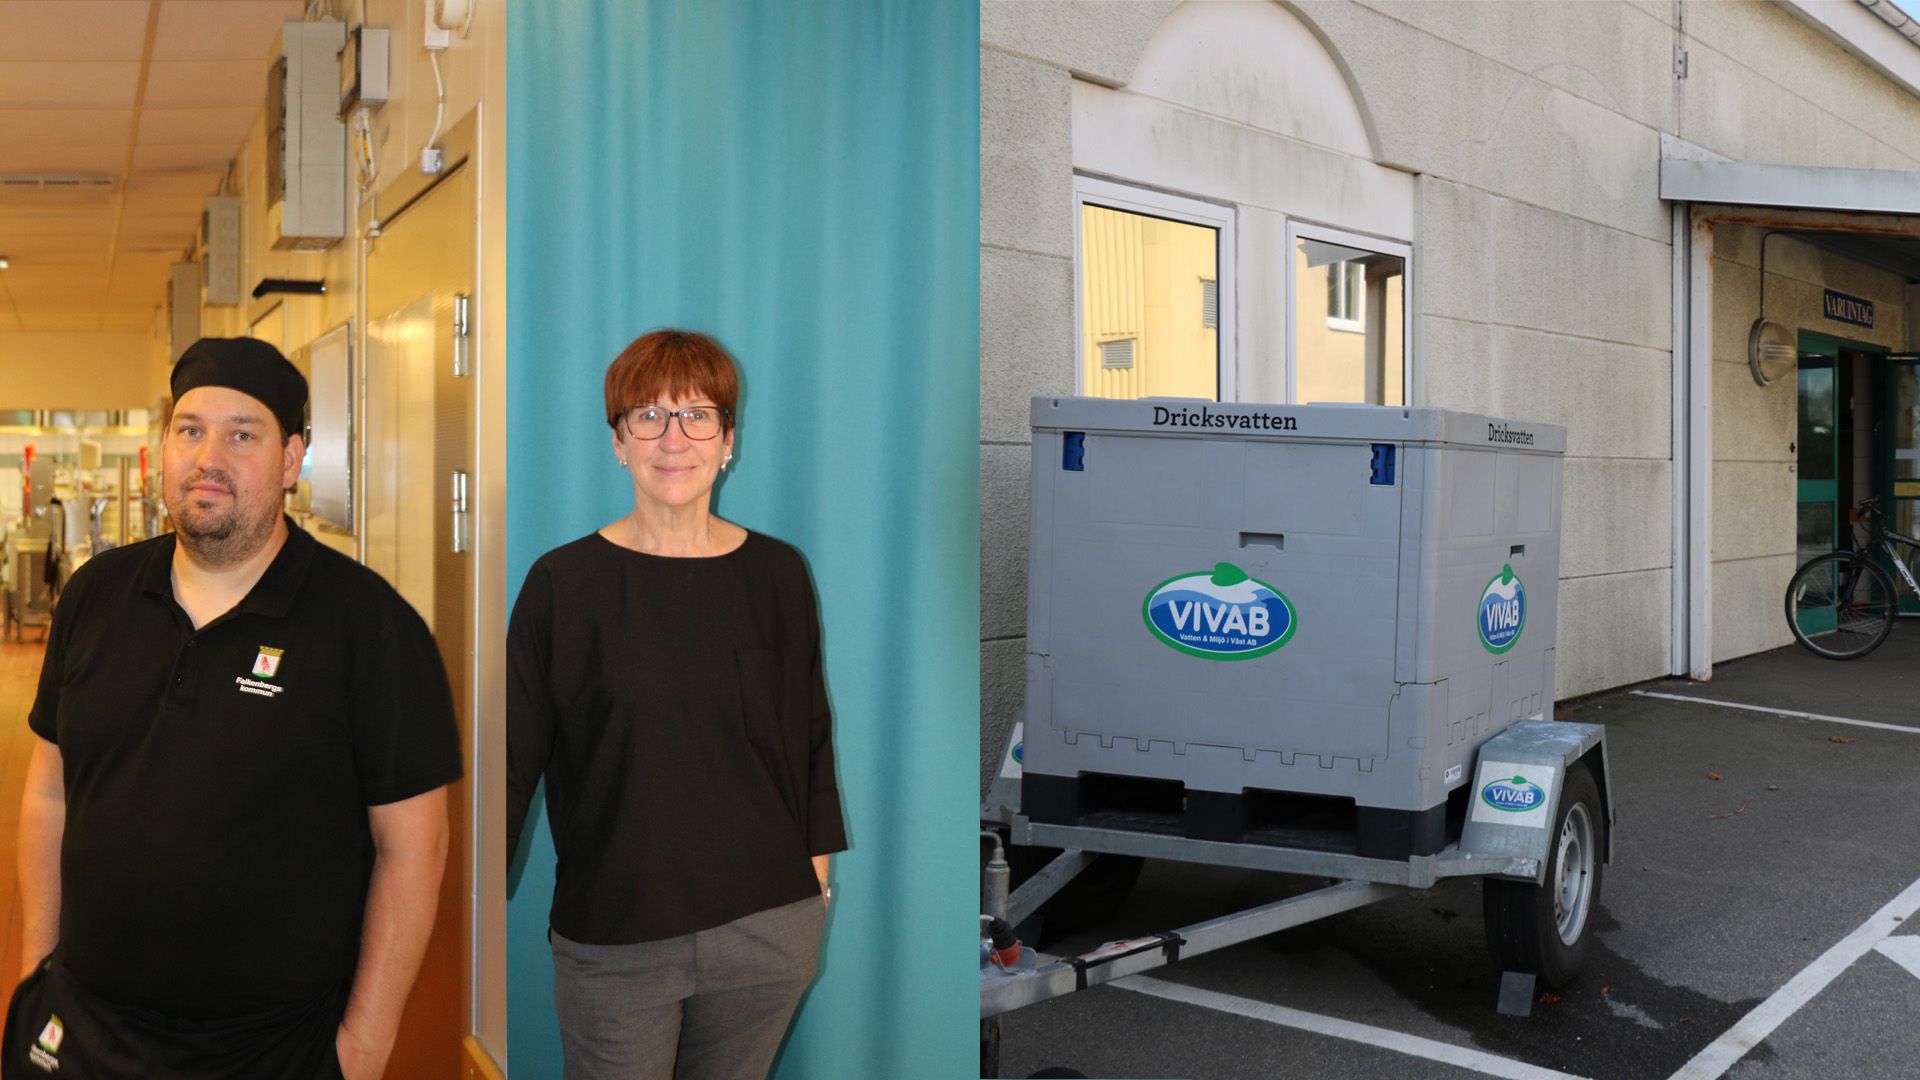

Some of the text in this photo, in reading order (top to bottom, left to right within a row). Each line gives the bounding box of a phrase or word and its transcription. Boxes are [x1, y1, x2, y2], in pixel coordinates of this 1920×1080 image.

[1825, 294, 1872, 325] VARUINTAG
[1153, 406, 1298, 430] Dricksvatten
[1488, 423, 1534, 445] Dricksvatten
[1168, 600, 1270, 637] VIVAB
[1486, 600, 1519, 632] VIVAB
[1179, 633, 1201, 642] Vatten
[1202, 634, 1208, 642] &
[235, 676, 284, 693] Falkenbergs
[239, 684, 275, 698] kommun
[1492, 788, 1535, 804] VIVAB
